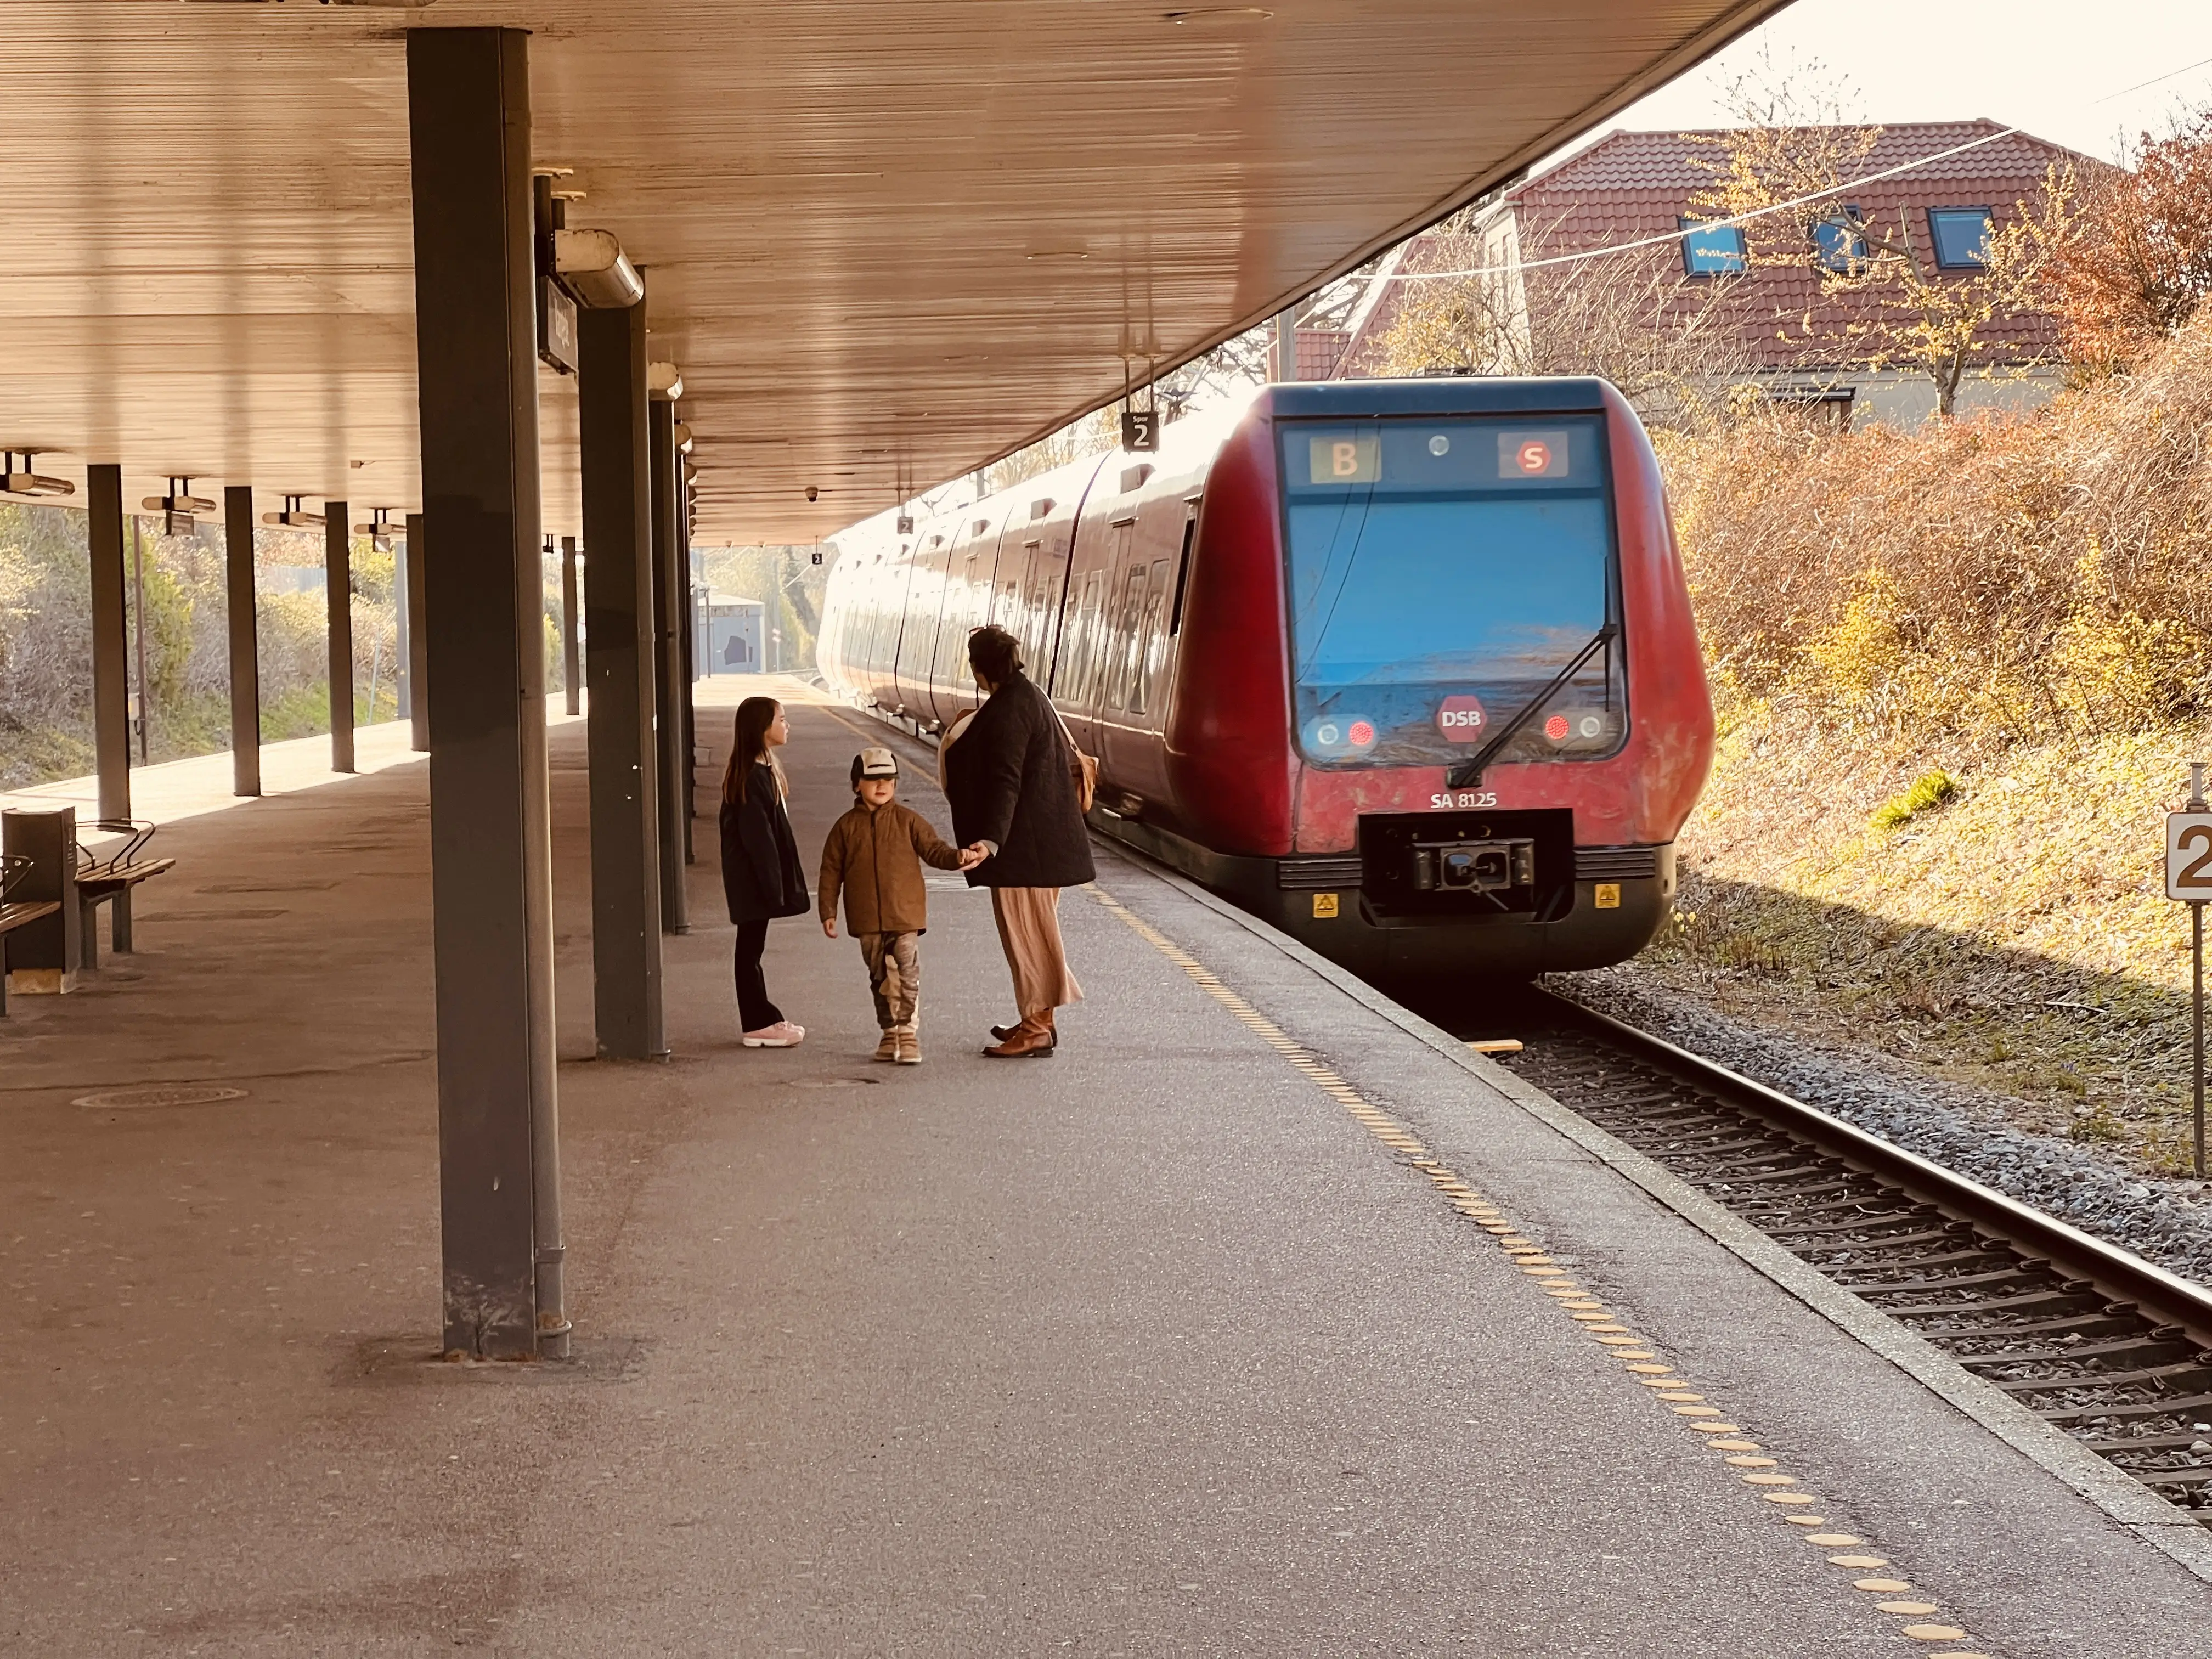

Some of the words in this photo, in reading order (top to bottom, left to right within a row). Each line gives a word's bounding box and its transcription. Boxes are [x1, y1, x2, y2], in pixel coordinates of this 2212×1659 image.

[1134, 424, 1149, 446] 2
[1333, 443, 1358, 476] B
[1525, 447, 1543, 469] S
[902, 522, 910, 532] 2
[1442, 711, 1481, 726] DSB
[1430, 794, 1454, 808] SA
[1458, 793, 1497, 808] 8125
[2176, 825, 2212, 888] 2
